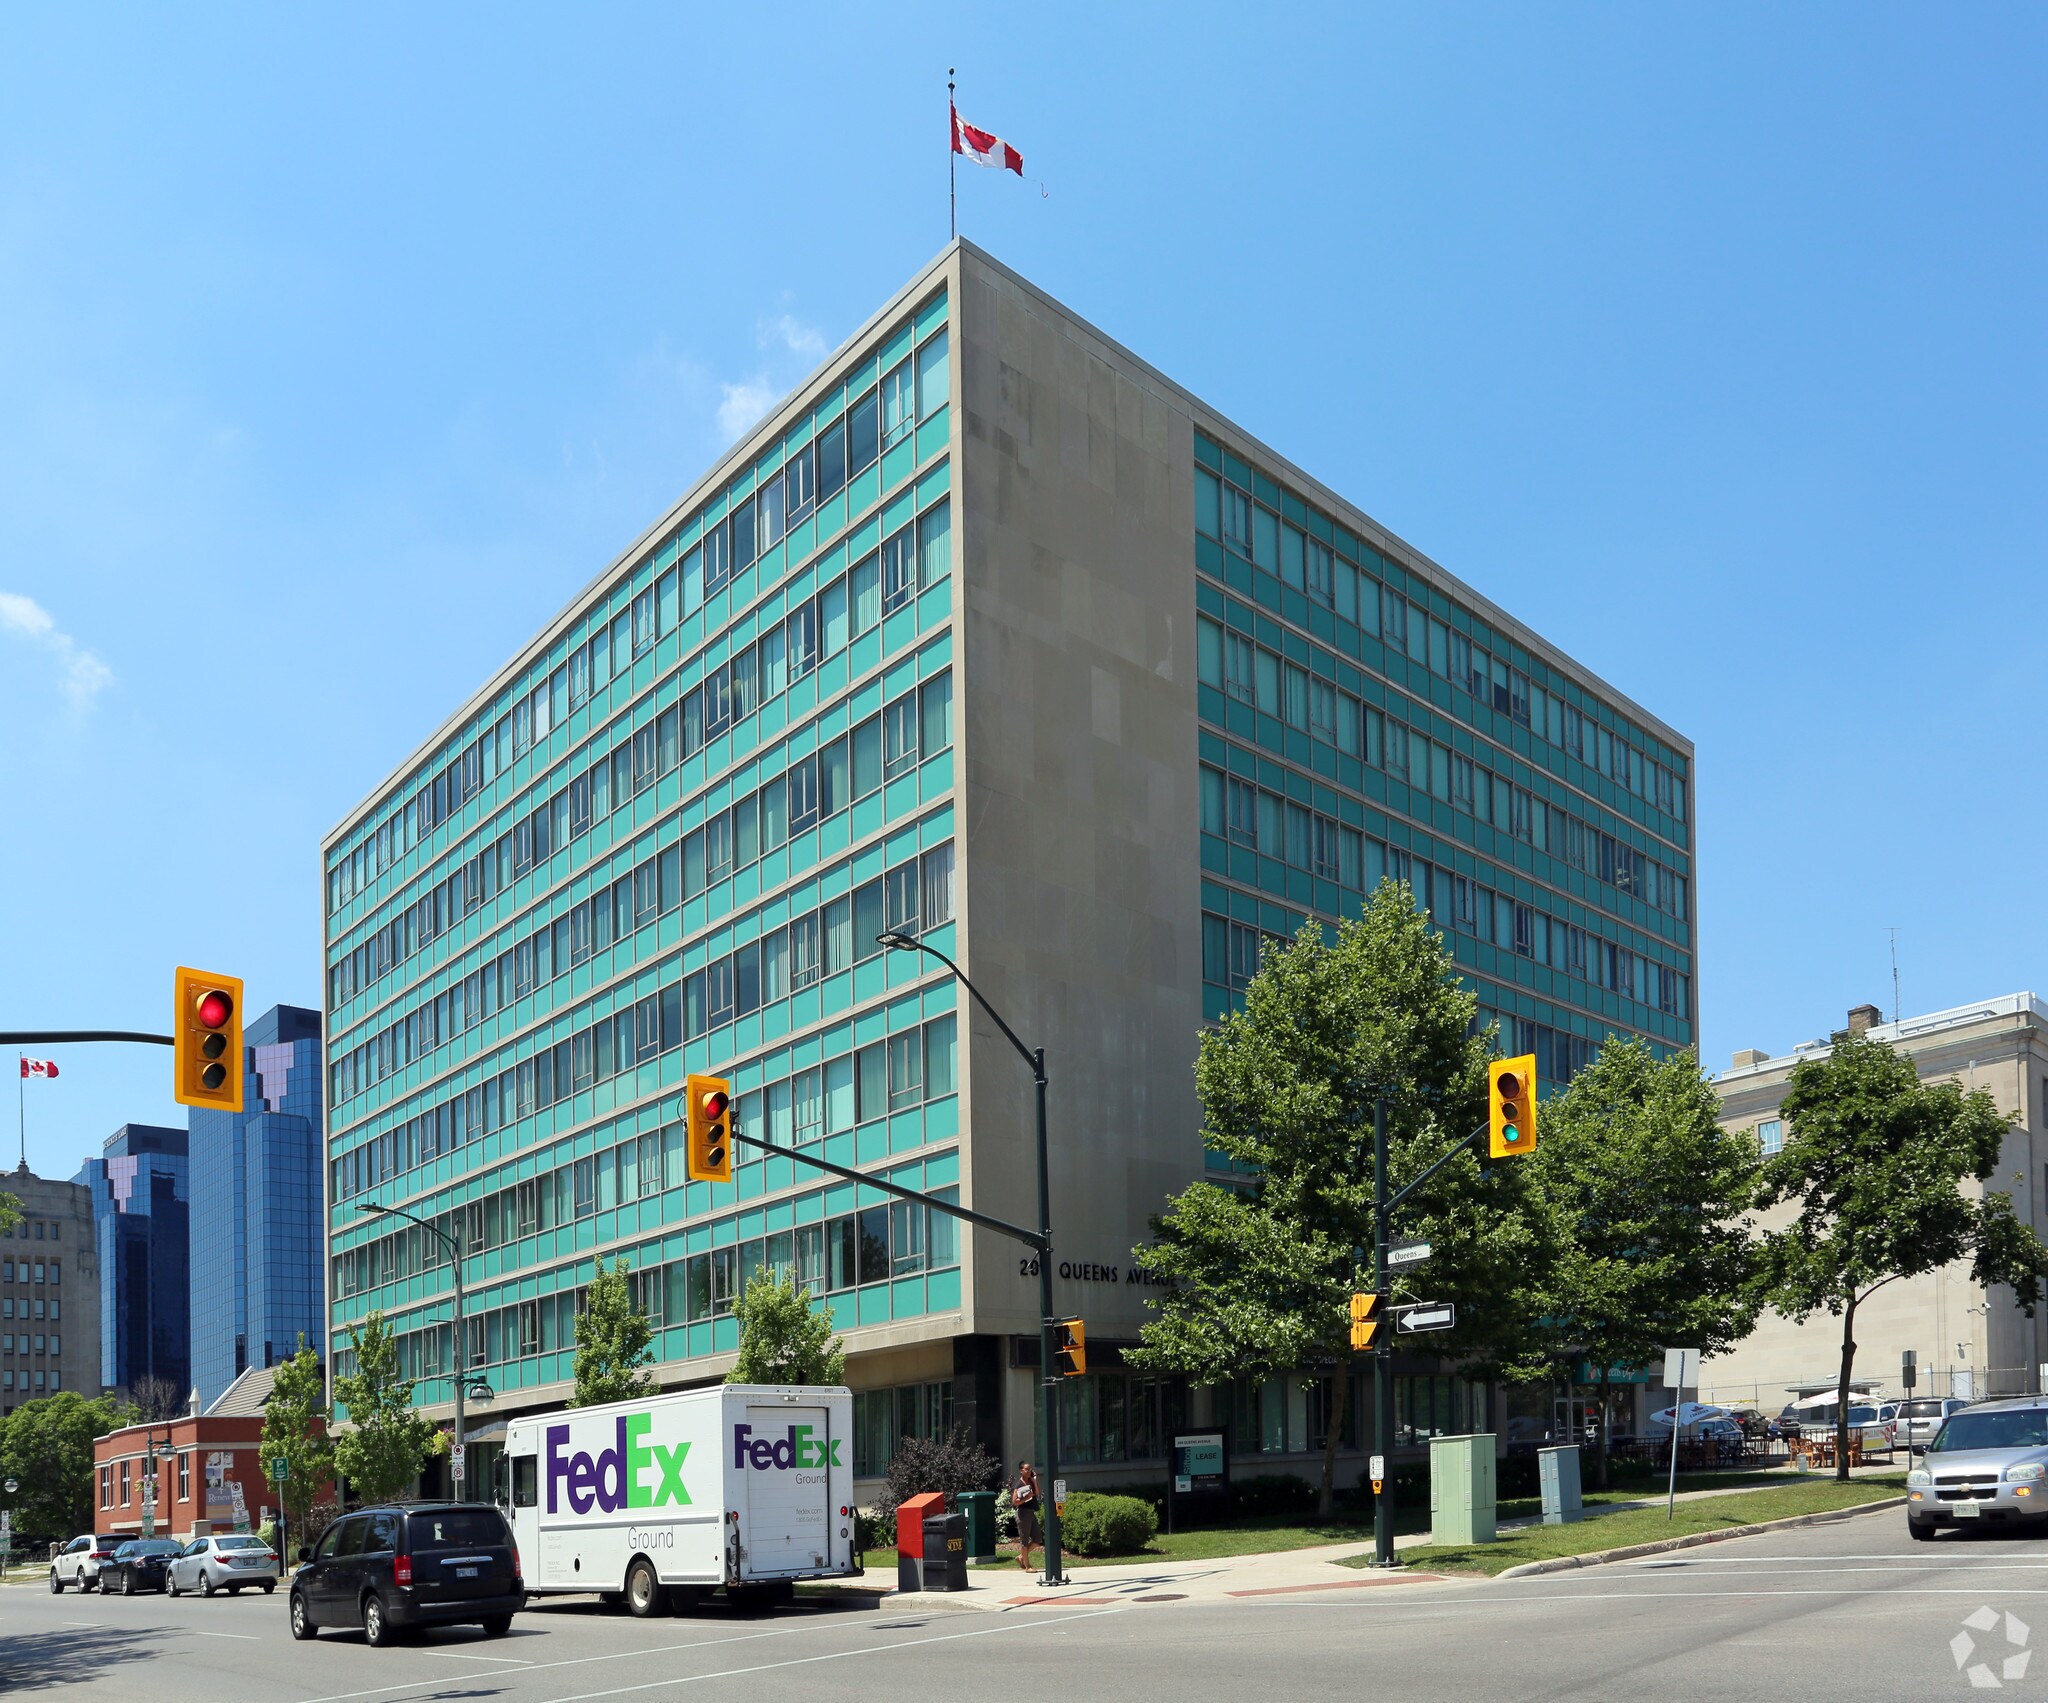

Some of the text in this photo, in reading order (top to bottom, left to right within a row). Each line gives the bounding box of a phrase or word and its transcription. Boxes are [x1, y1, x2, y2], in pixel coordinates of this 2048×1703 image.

[1394, 1250, 1417, 1261] Queens
[1059, 1261, 1118, 1283] QUEENS
[734, 1424, 842, 1470] FedEx
[276, 1460, 284, 1468] P
[547, 1412, 693, 1515] FedEx
[796, 1473, 828, 1484] Ground
[208, 1493, 231, 1503] Renew
[628, 1526, 674, 1549] Ground
